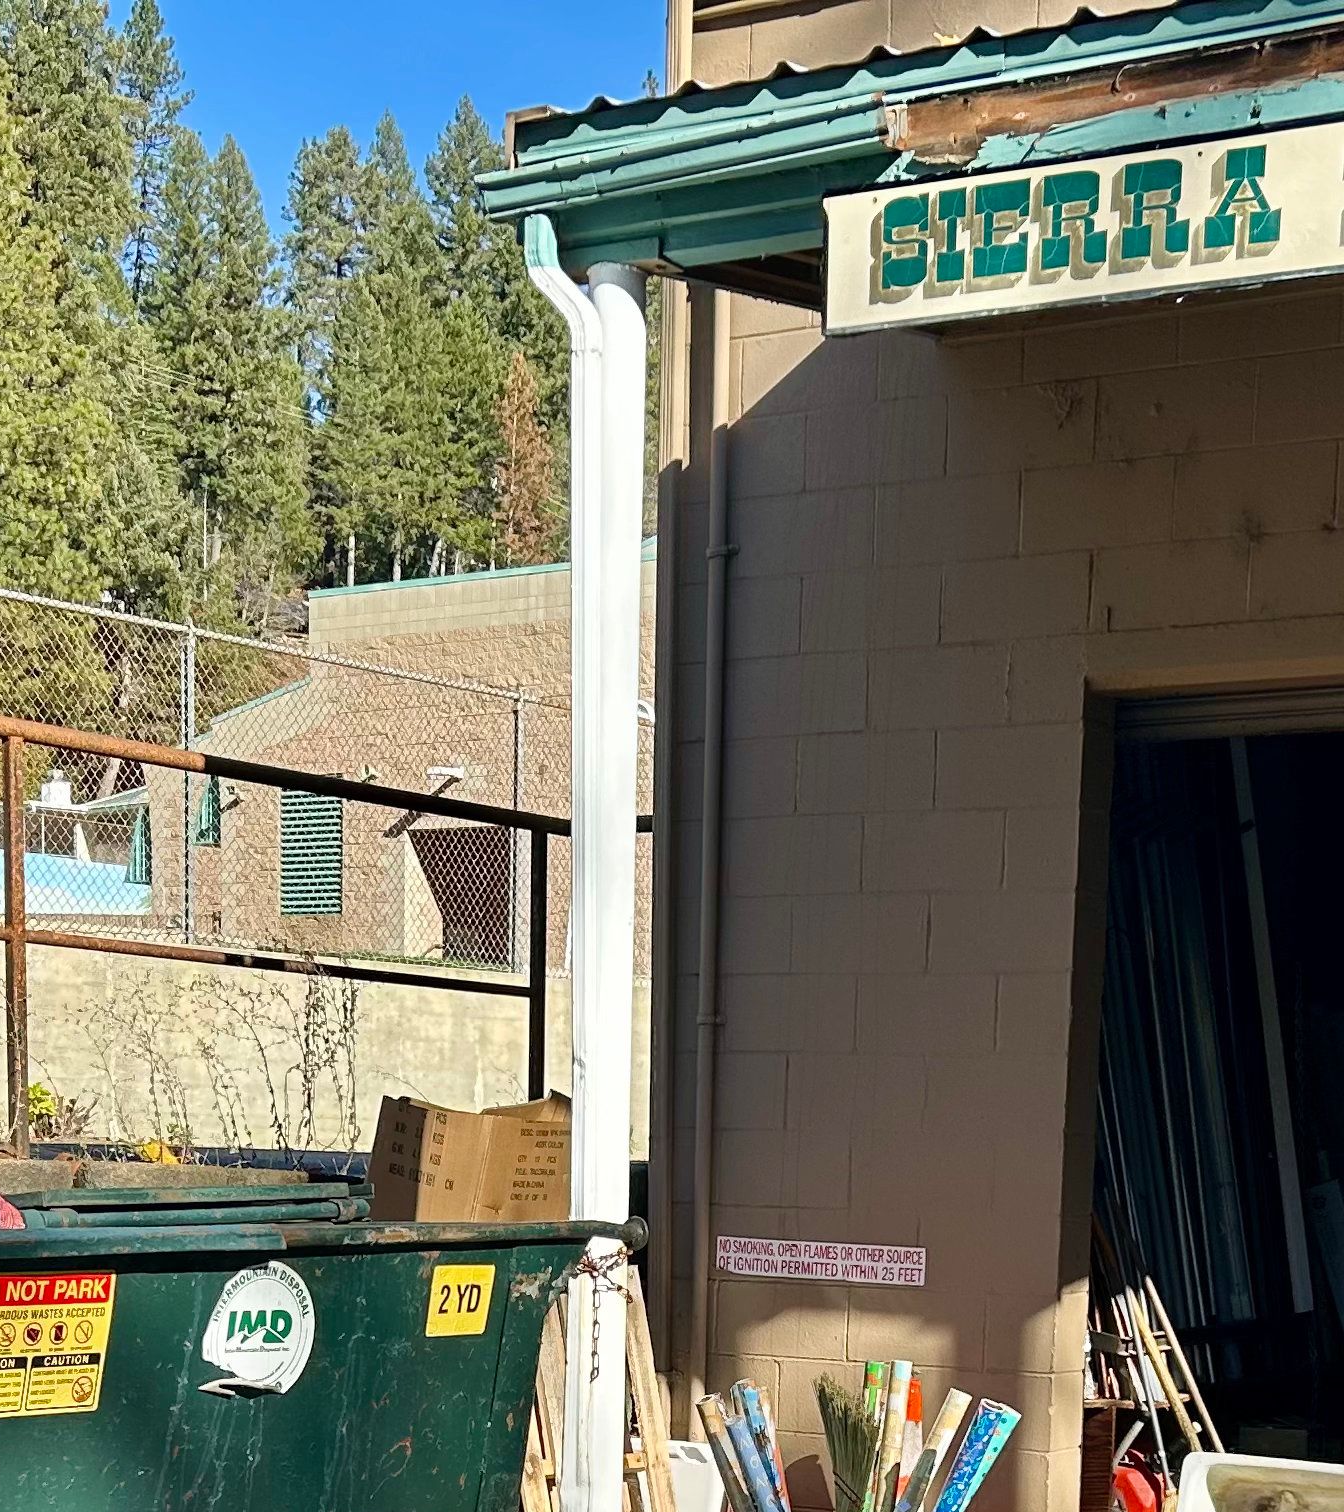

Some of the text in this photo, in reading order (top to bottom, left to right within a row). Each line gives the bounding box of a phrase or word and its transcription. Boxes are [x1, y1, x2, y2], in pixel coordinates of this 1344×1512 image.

[870, 143, 1281, 306] SIERRA
[719, 1239, 731, 1253] NO
[777, 1243, 801, 1258] OPEN
[804, 1245, 838, 1260] FLAMES
[841, 1247, 854, 1261] OR
[855, 1248, 884, 1262] OTHER
[886, 1250, 924, 1265] SOURCE
[719, 1256, 922, 1283] OF IGNITION PERMITTED WITHIN 25 FEET
[6, 1280, 49, 1301] NOT
[53, 1277, 108, 1299] PARK
[279, 1270, 310, 1319] DISPOSAL
[438, 1285, 482, 1313] 2 YD
[31, 1309, 64, 1319] WASTES
[65, 1307, 106, 1317] ACCEPTED
[226, 1310, 292, 1343] IMD
[44, 1355, 89, 1367] CAUTION
